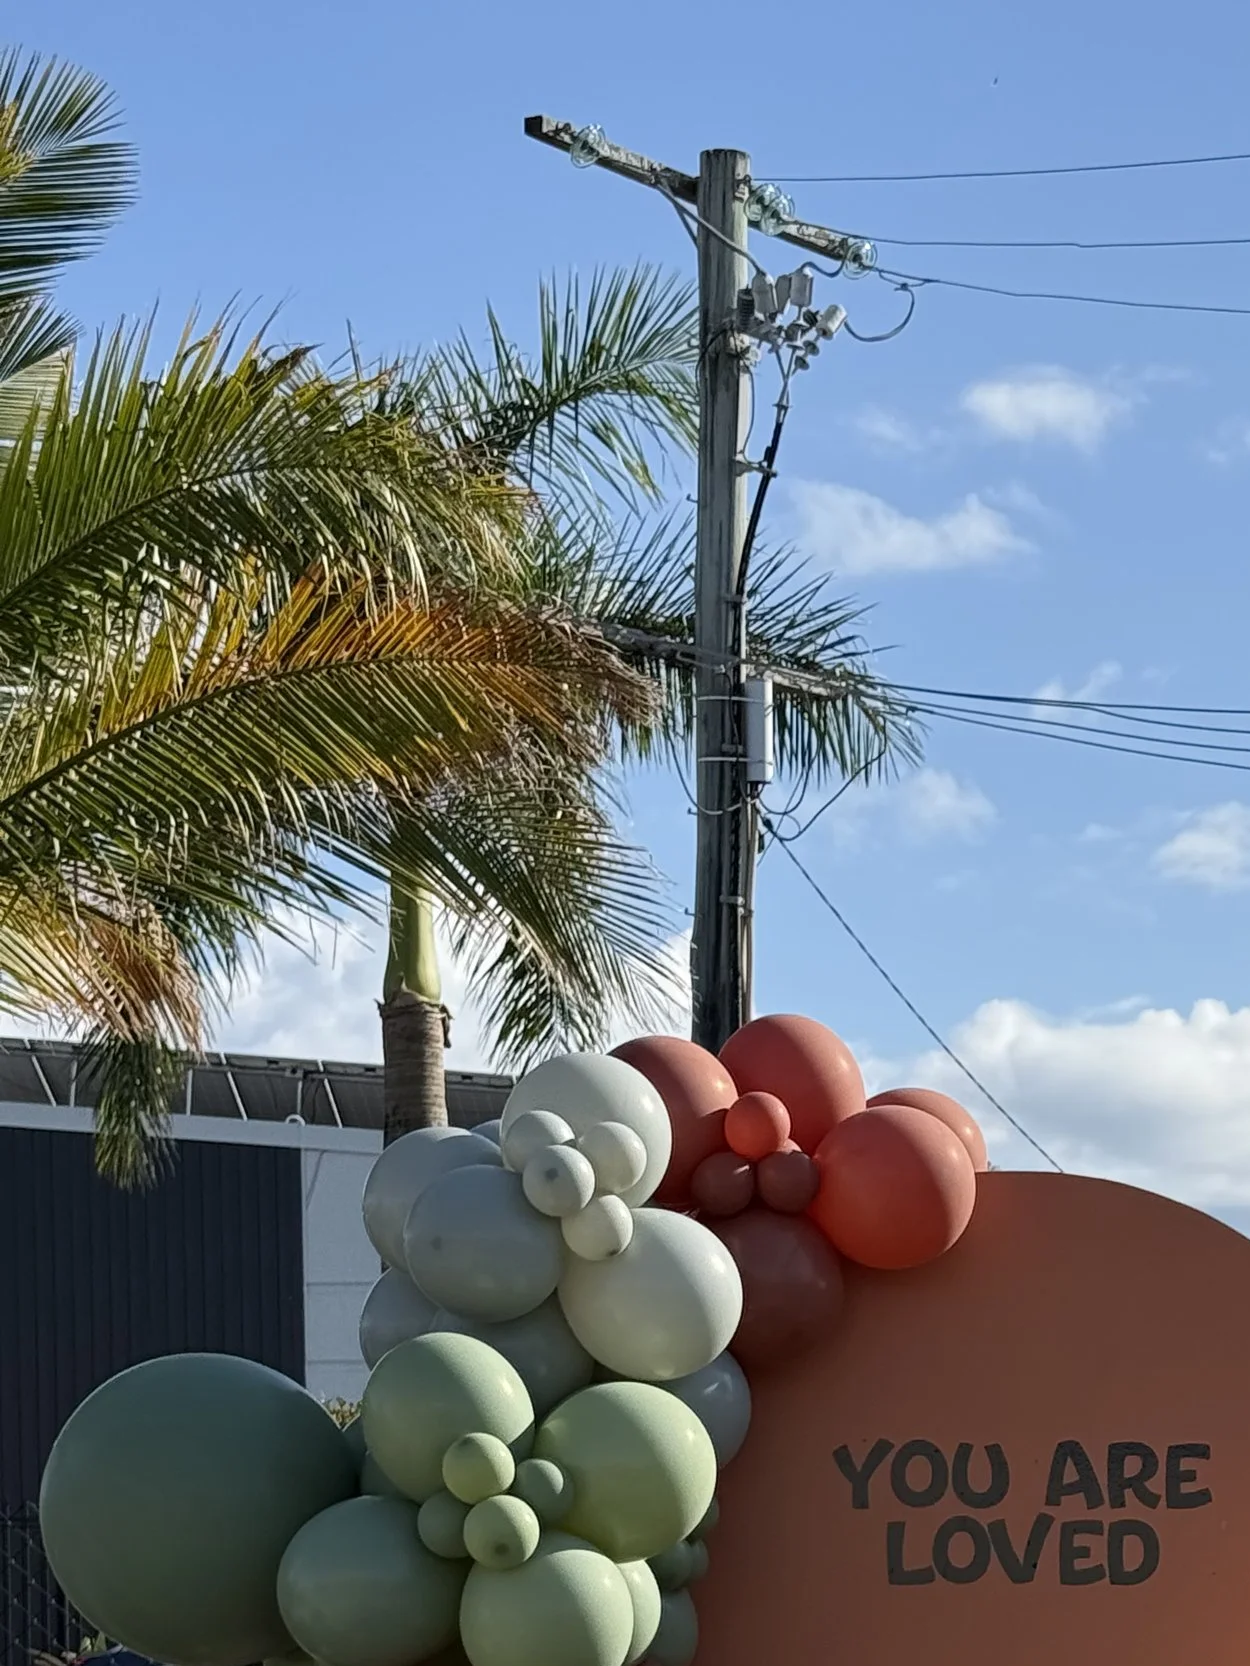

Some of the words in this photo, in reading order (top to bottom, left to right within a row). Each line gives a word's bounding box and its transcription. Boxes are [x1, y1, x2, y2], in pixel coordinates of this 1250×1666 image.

[832, 1438, 1010, 1509] YOU
[1045, 1440, 1213, 1510] ARE
[887, 1512, 1161, 1585] LOVED
